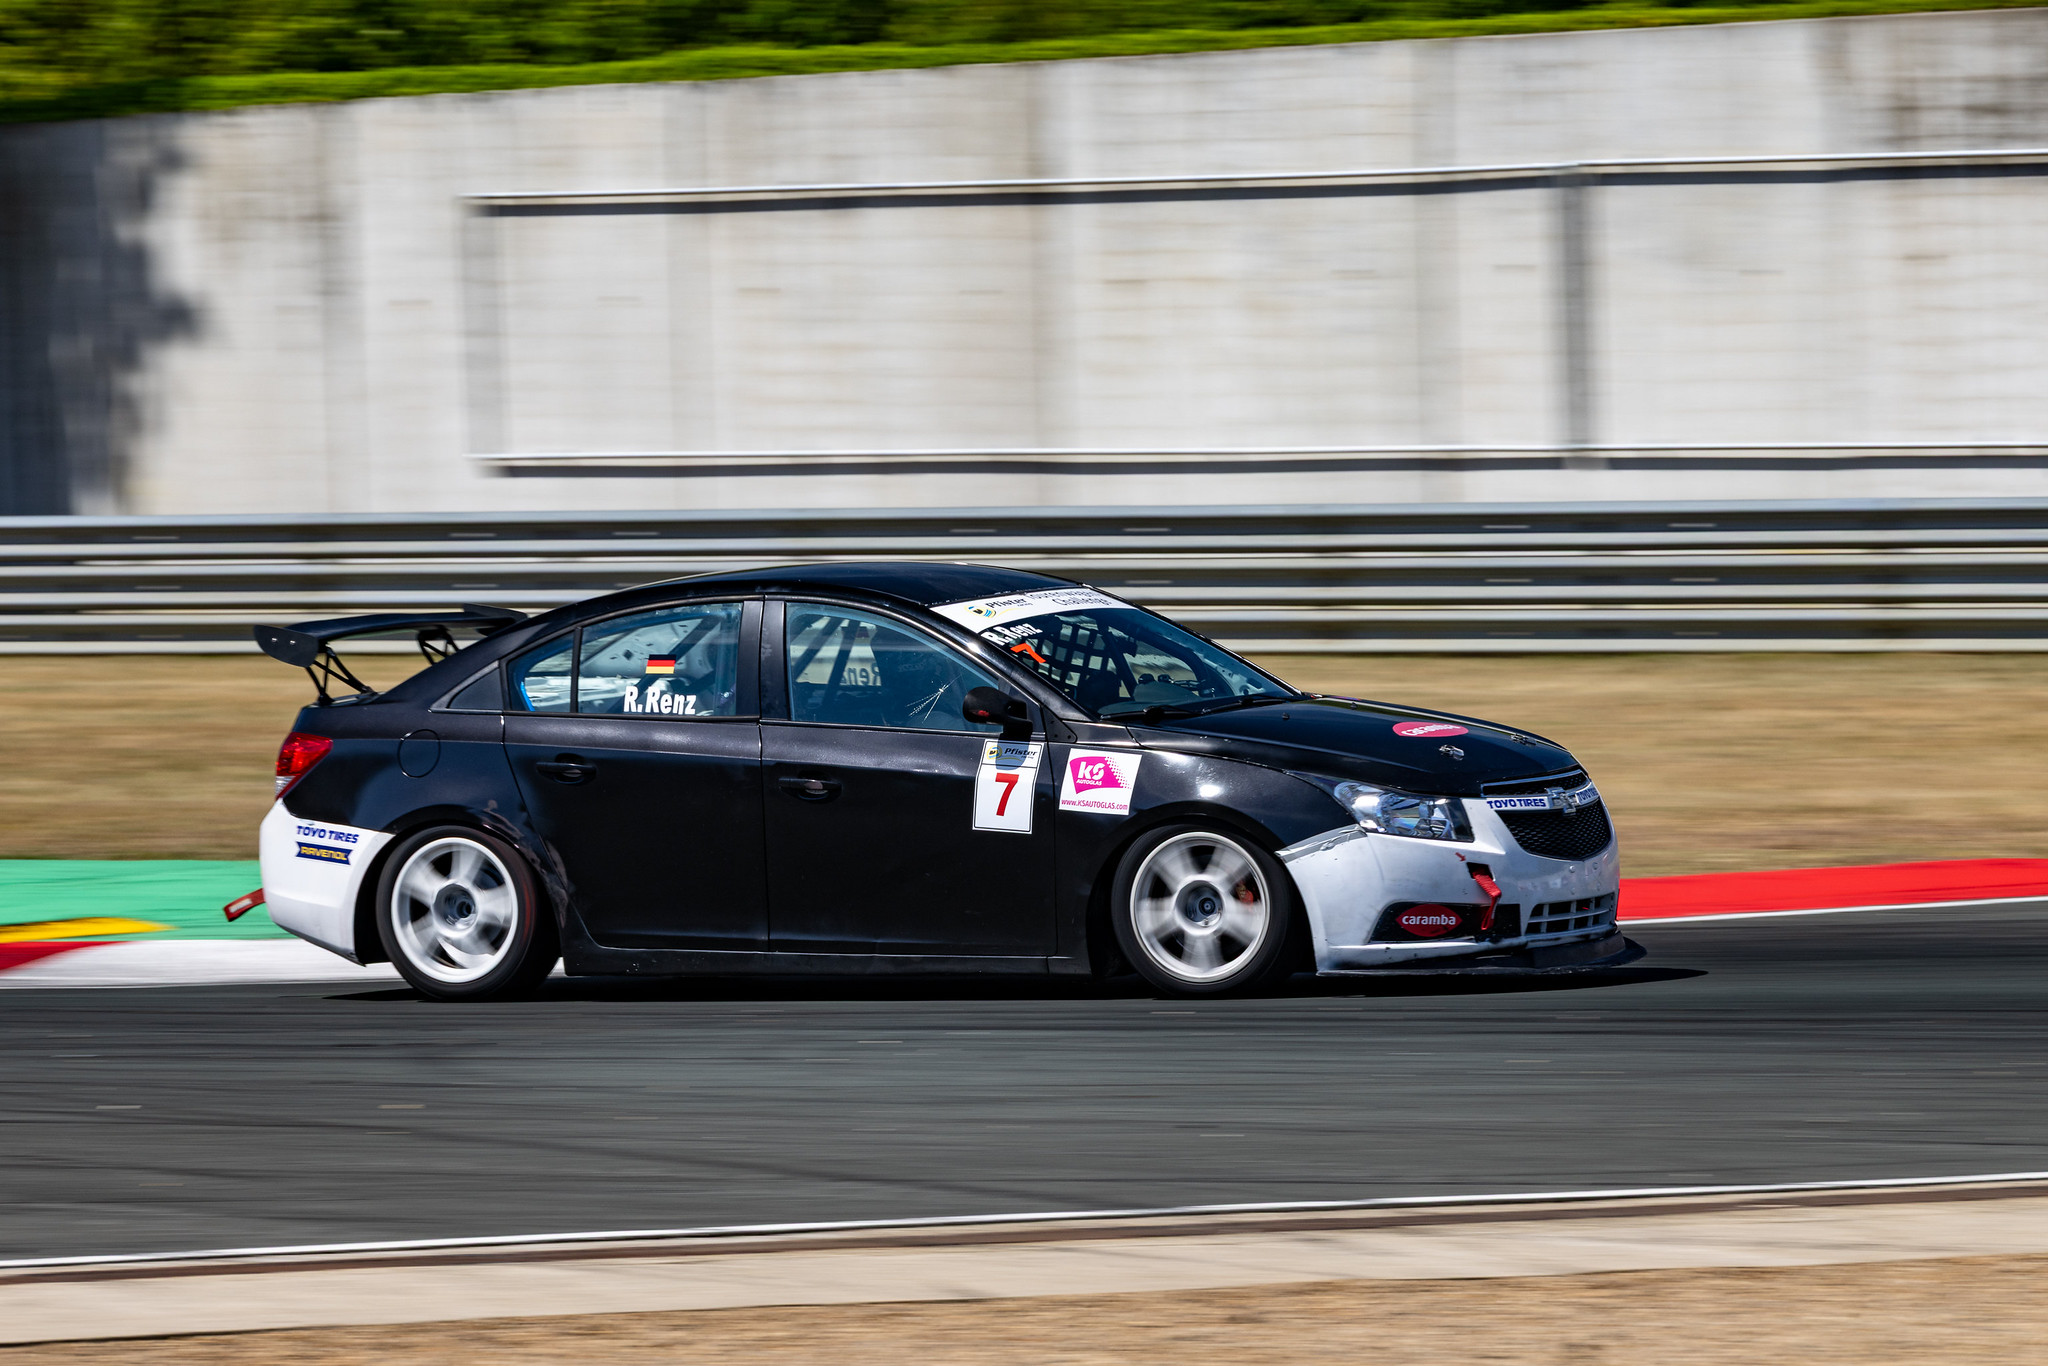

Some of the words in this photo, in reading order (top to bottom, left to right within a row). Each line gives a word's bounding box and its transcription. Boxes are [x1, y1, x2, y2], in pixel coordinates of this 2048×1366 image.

[1010, 643, 1047, 664] 7
[1004, 747, 1038, 756] Pfister
[1076, 778, 1103, 786] AUTOGLAS
[995, 772, 1020, 816] 7
[1061, 799, 1129, 811] www.KSAUTOGLAS.com
[1486, 799, 1517, 809] TOYO
[1516, 798, 1547, 807] TIRES
[296, 825, 327, 839] TOYO
[328, 830, 360, 844] TIRES
[300, 846, 348, 861] RAVENOL
[1401, 914, 1457, 925] caramba
